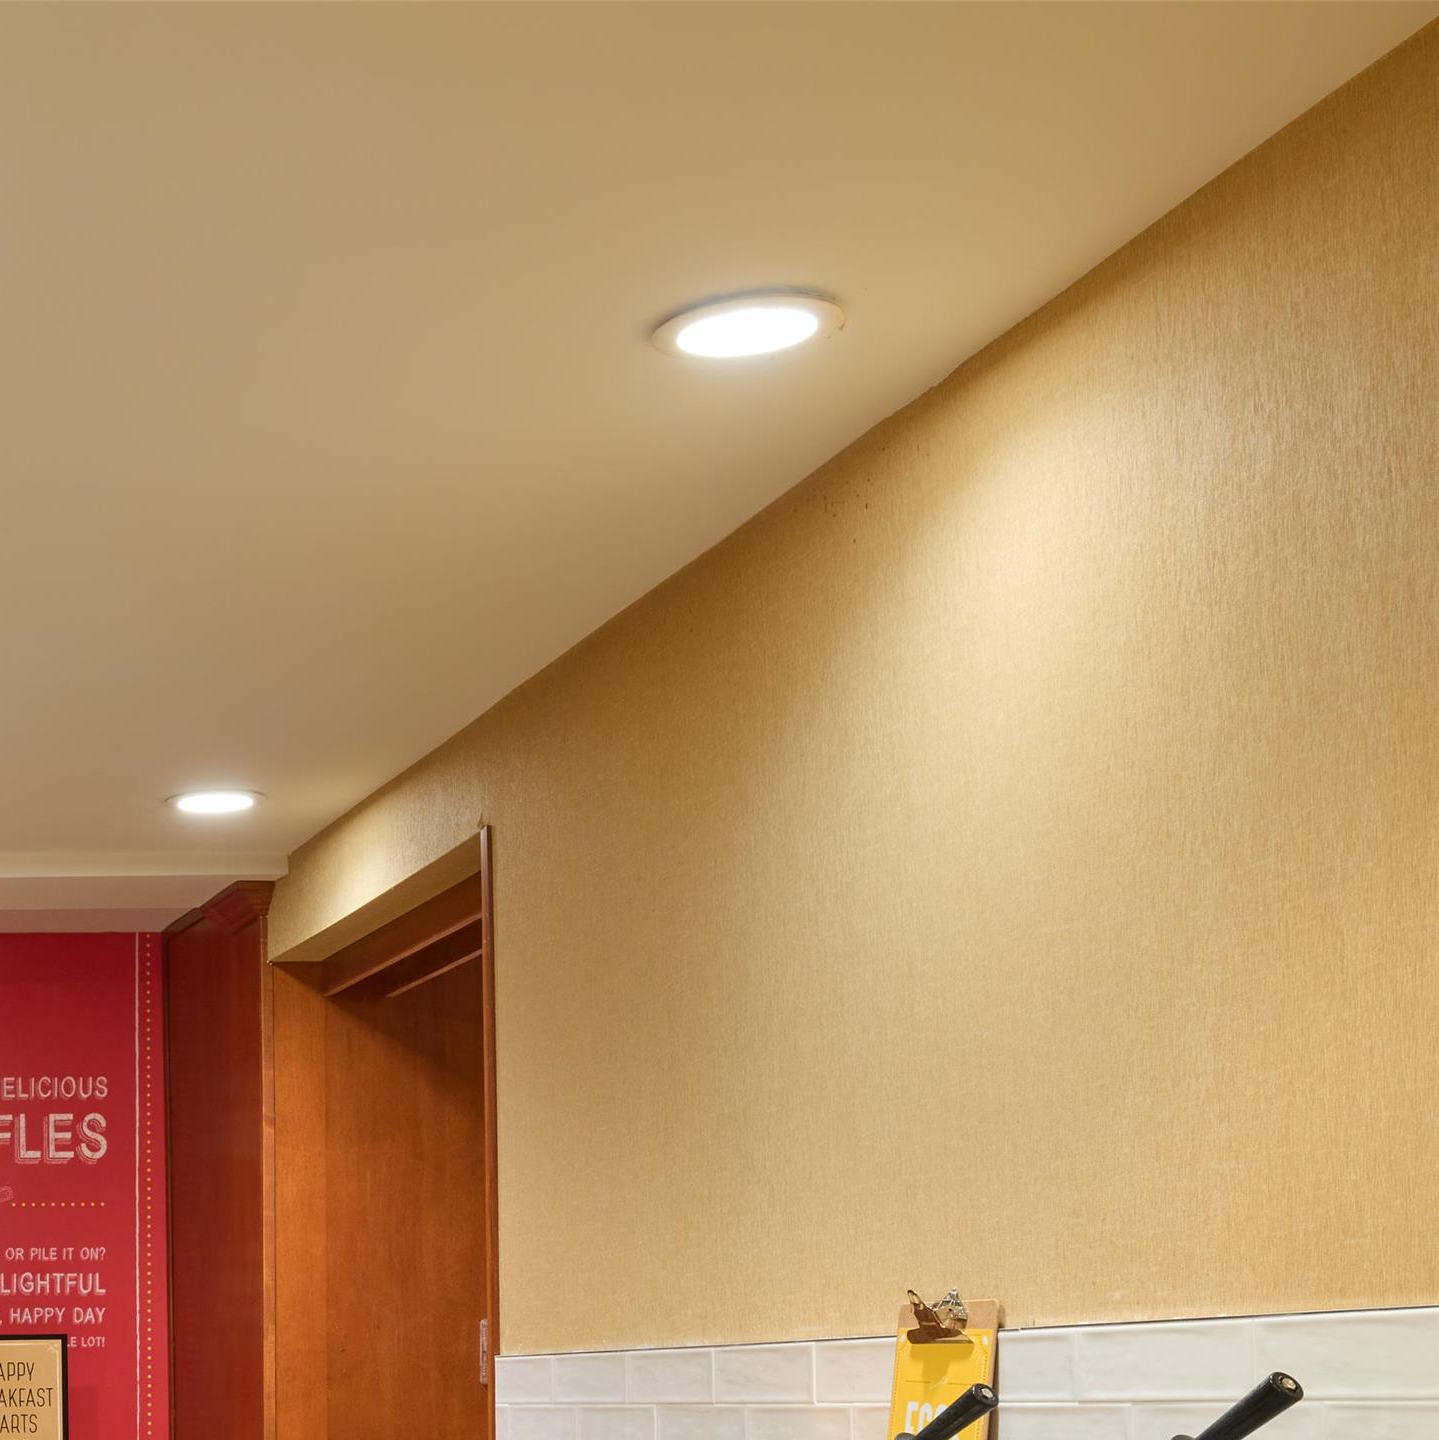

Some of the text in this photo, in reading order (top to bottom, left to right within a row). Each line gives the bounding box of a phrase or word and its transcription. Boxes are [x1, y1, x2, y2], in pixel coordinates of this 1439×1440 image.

[5, 1247, 24, 1260] OR
[30, 1247, 57, 1260] PILE
[62, 1247, 74, 1260] IT
[80, 1246, 106, 1260] ON?
[9, 1307, 66, 1325] HAPPY
[72, 1307, 106, 1324] DAY
[81, 1336, 106, 1348] LOT!
